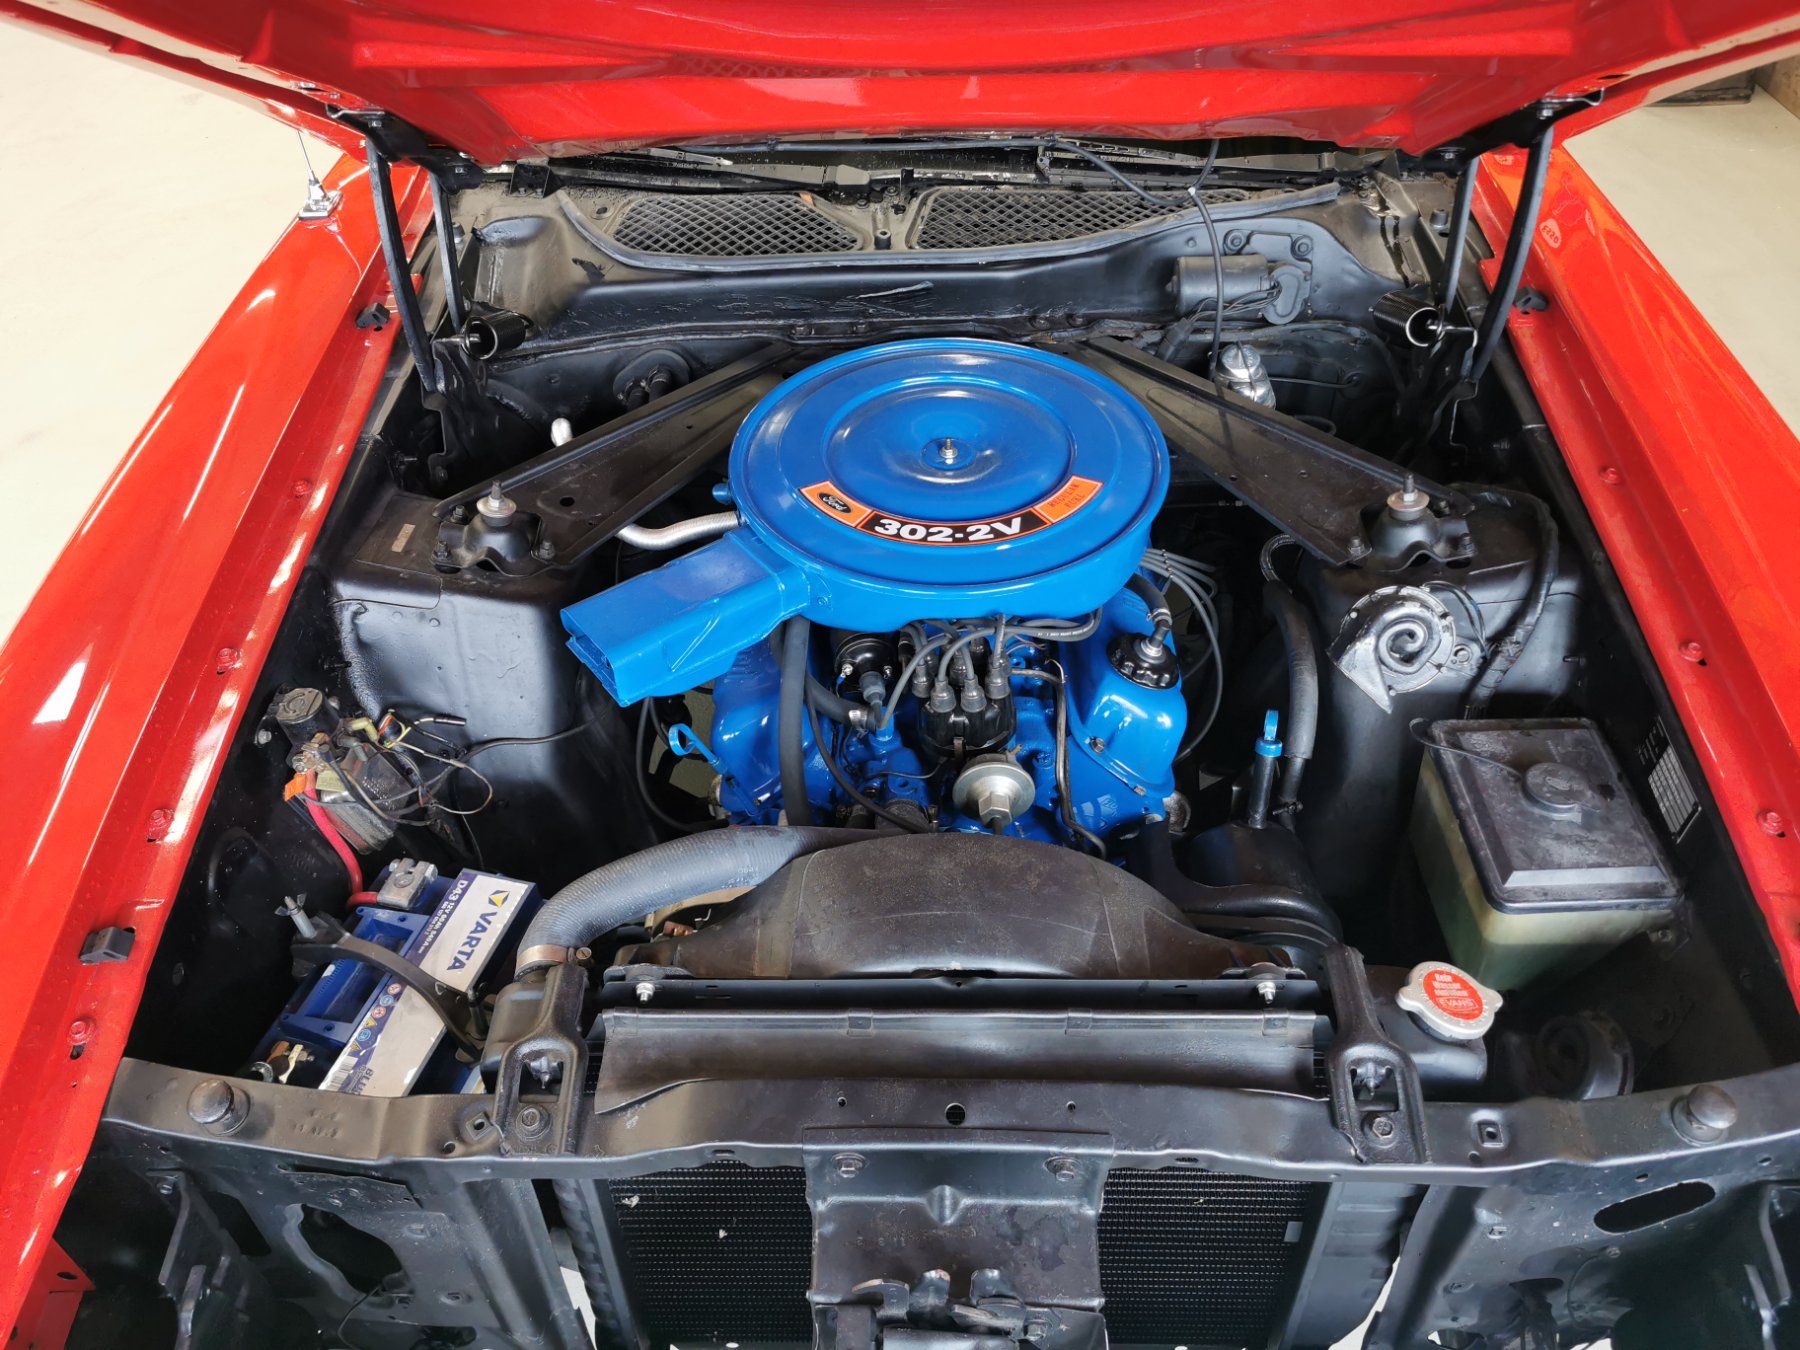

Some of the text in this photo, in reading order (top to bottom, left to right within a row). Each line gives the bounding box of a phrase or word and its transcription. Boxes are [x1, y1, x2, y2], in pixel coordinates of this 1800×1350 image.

[823, 496, 847, 511] Ford
[449, 879, 469, 901] D43
[445, 902, 455, 914] 12V
[446, 911, 498, 971] VARTA
